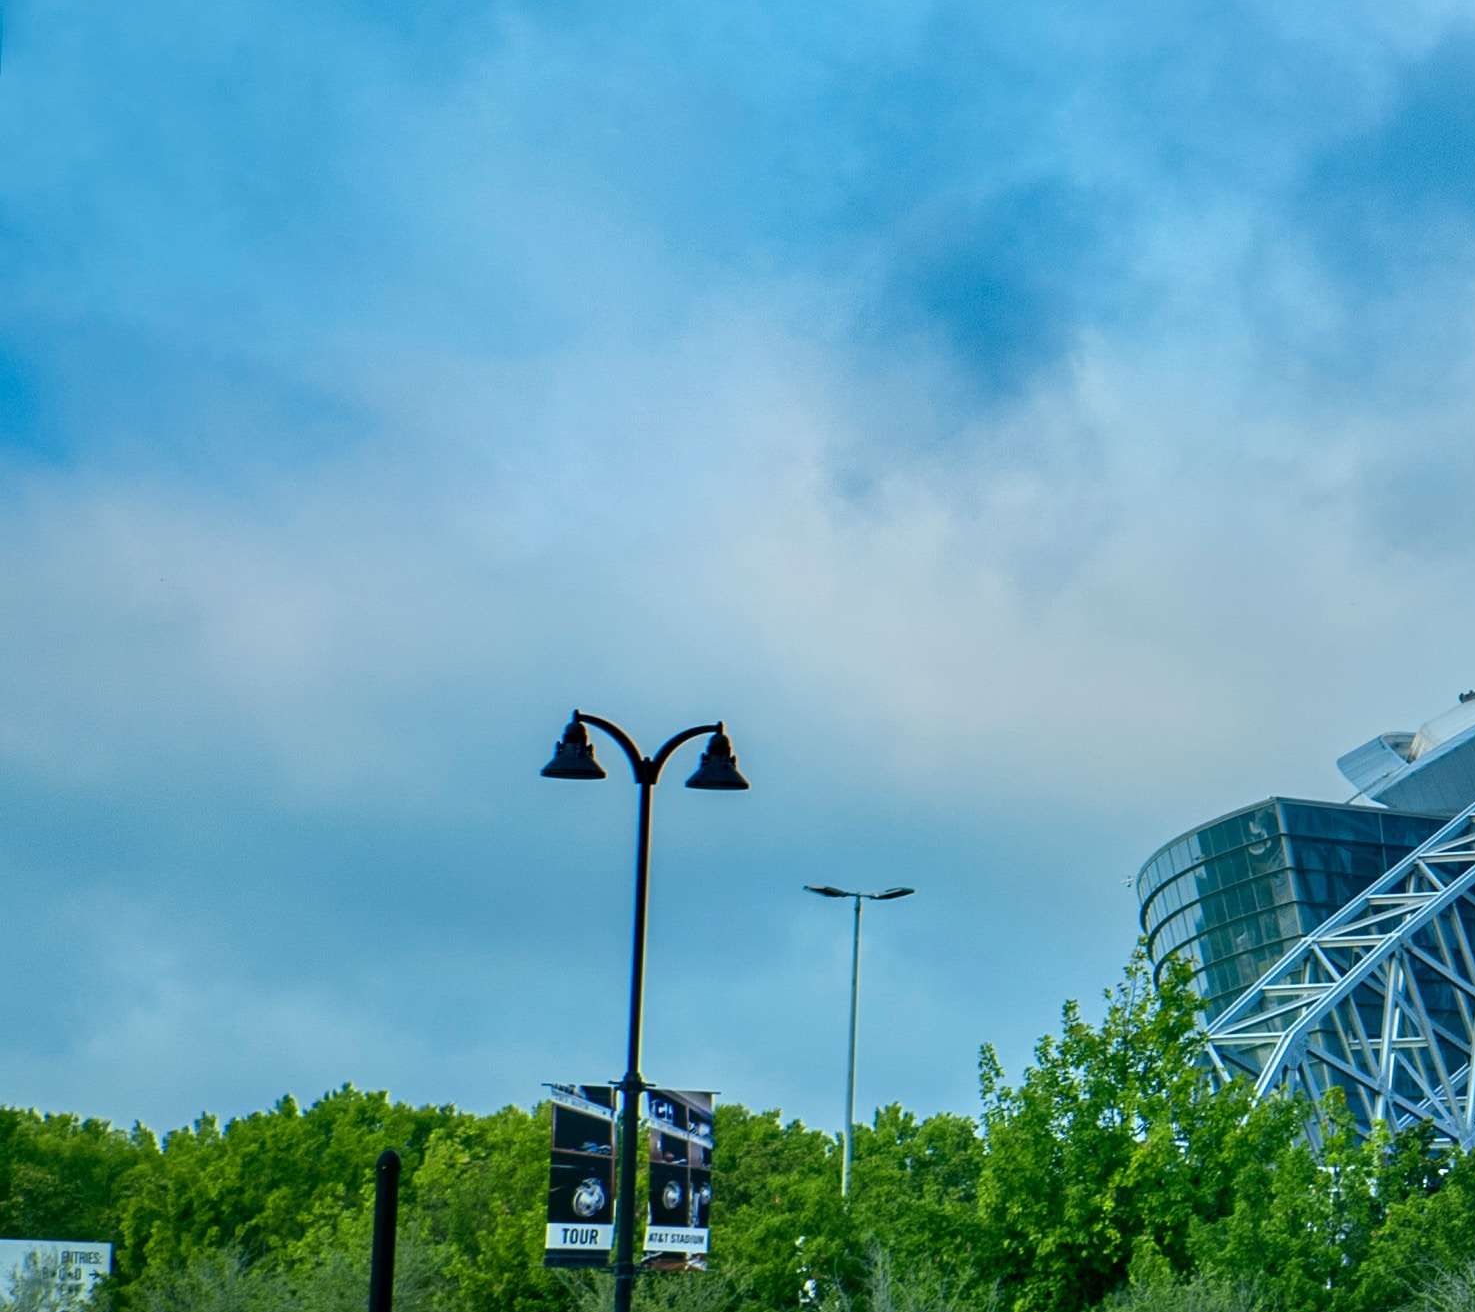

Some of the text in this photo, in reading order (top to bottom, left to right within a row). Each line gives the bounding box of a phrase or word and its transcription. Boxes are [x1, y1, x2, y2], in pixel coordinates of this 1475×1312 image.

[562, 1229, 598, 1244] TOUR
[648, 1233, 704, 1244] AT&T STADIUM
